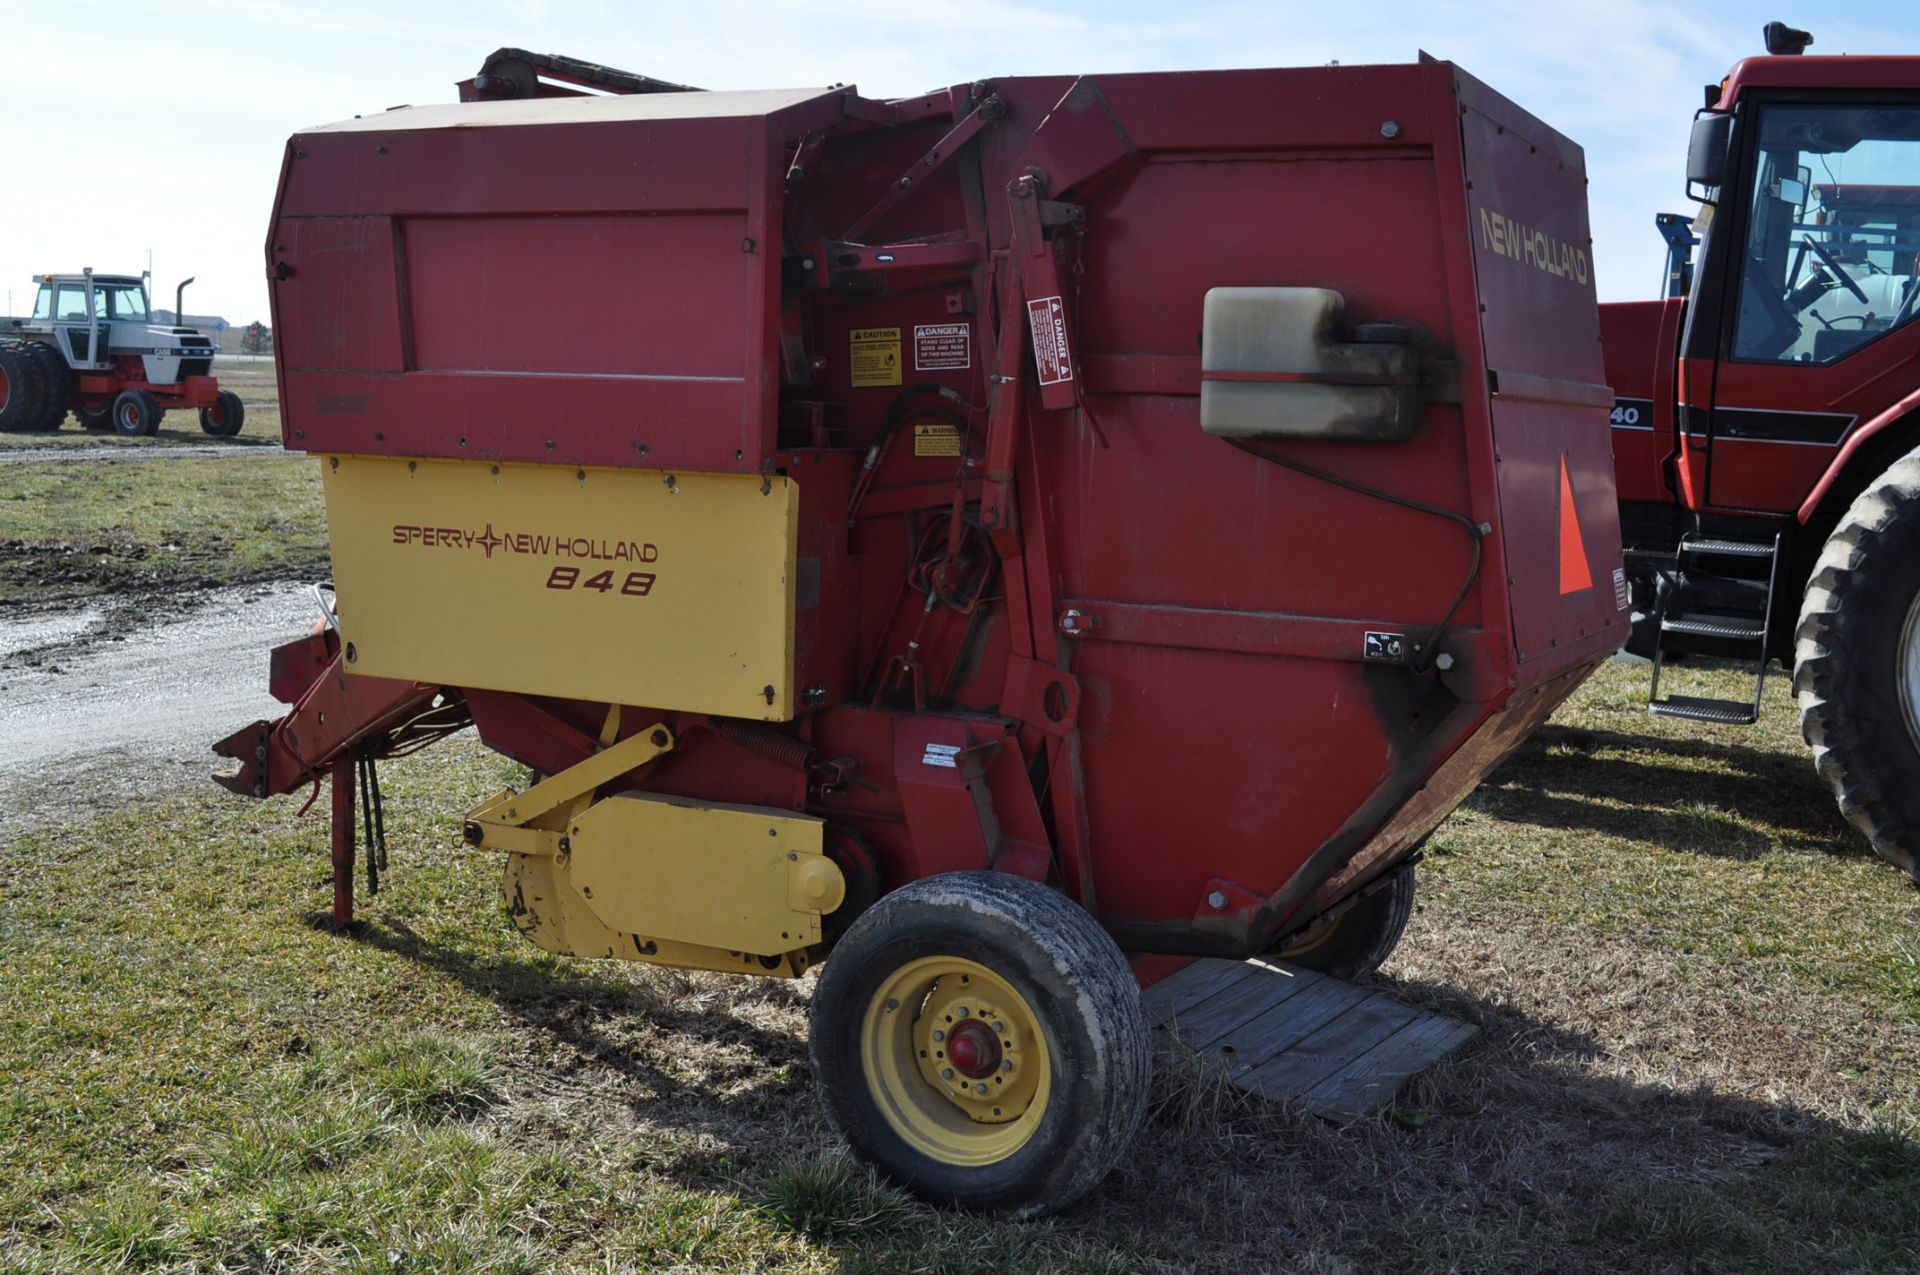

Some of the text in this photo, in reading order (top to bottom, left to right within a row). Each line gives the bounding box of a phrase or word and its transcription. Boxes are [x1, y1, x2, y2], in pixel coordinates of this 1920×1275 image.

[1480, 207, 1587, 285] NEW HOLLAND
[863, 330, 897, 338] CAUTION
[925, 327, 959, 336] DANGER
[1054, 319, 1067, 358] DANGER
[392, 525, 658, 564] SPERRY NEW HOLLAND
[546, 566, 657, 597] 848
